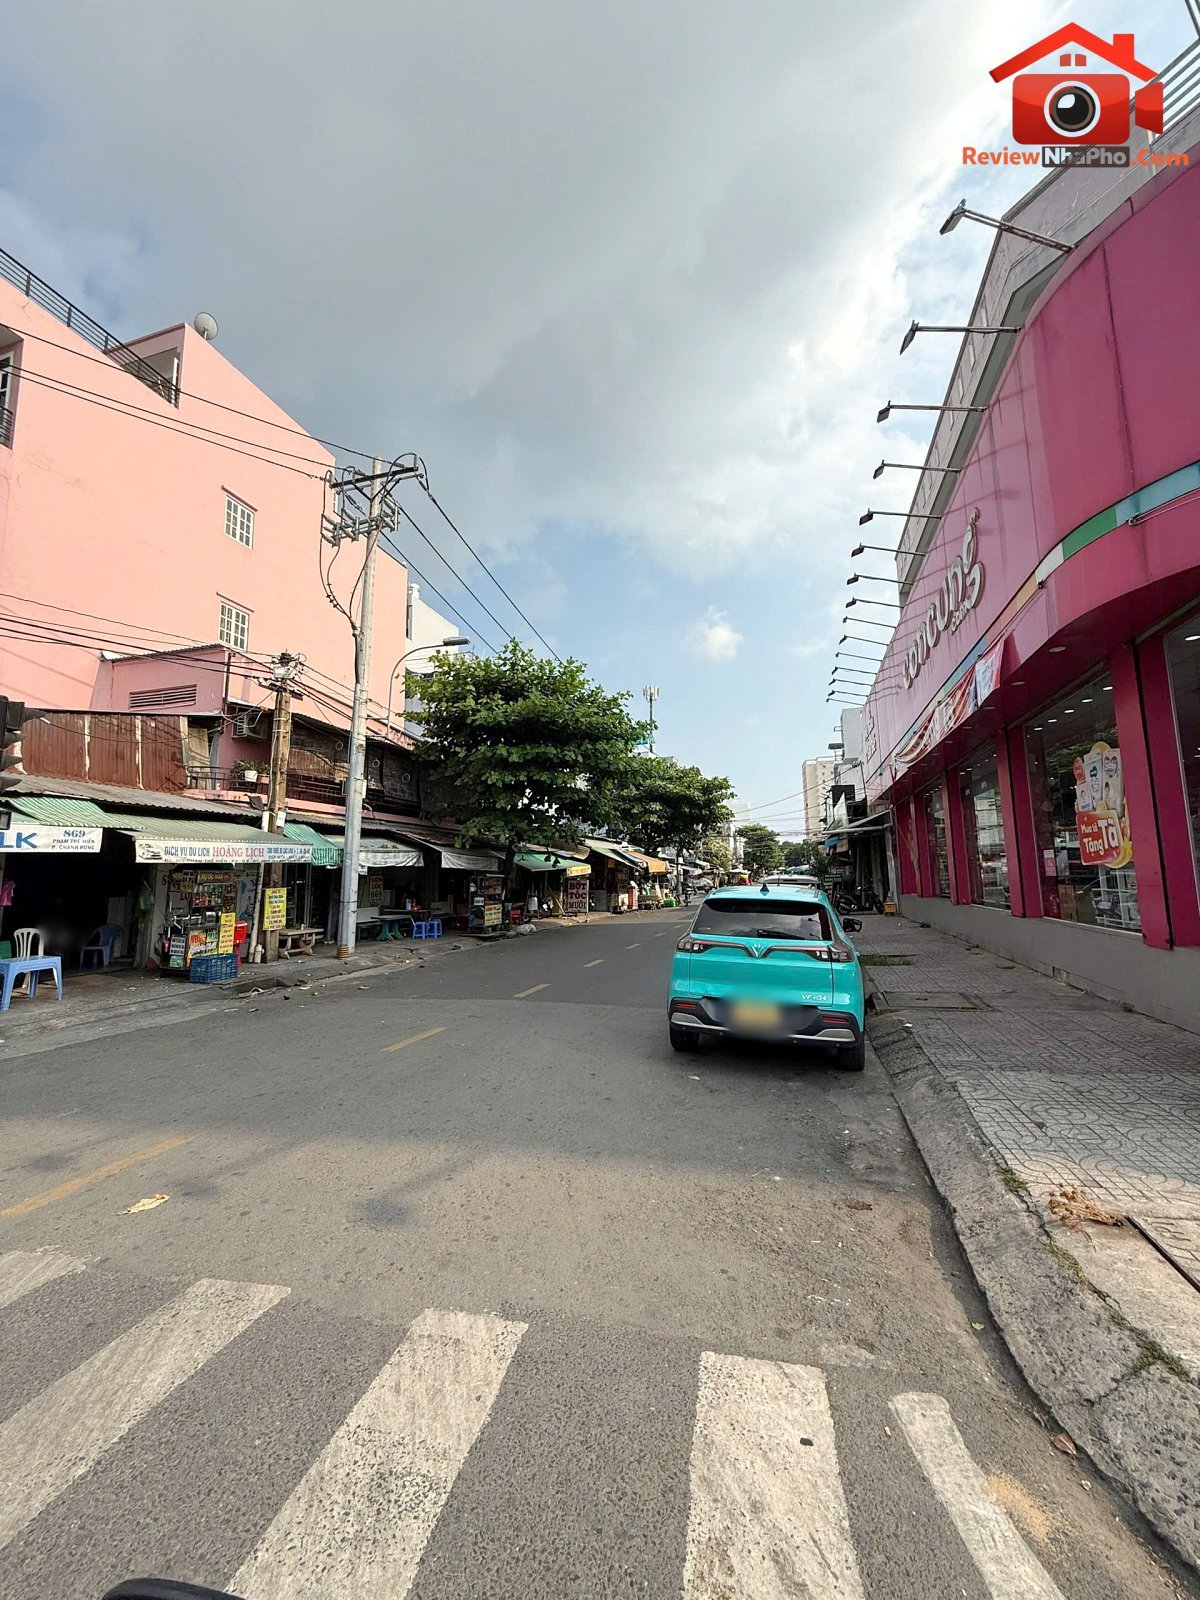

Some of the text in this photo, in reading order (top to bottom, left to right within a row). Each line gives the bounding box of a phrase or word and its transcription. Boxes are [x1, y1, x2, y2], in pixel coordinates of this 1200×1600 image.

[63, 829, 86, 838] 869
[1080, 824, 1093, 834] Mua
[1097, 818, 1119, 850] Tã
[212, 845, 244, 858] HOÀNG
[569, 890, 587, 899] TÓC
